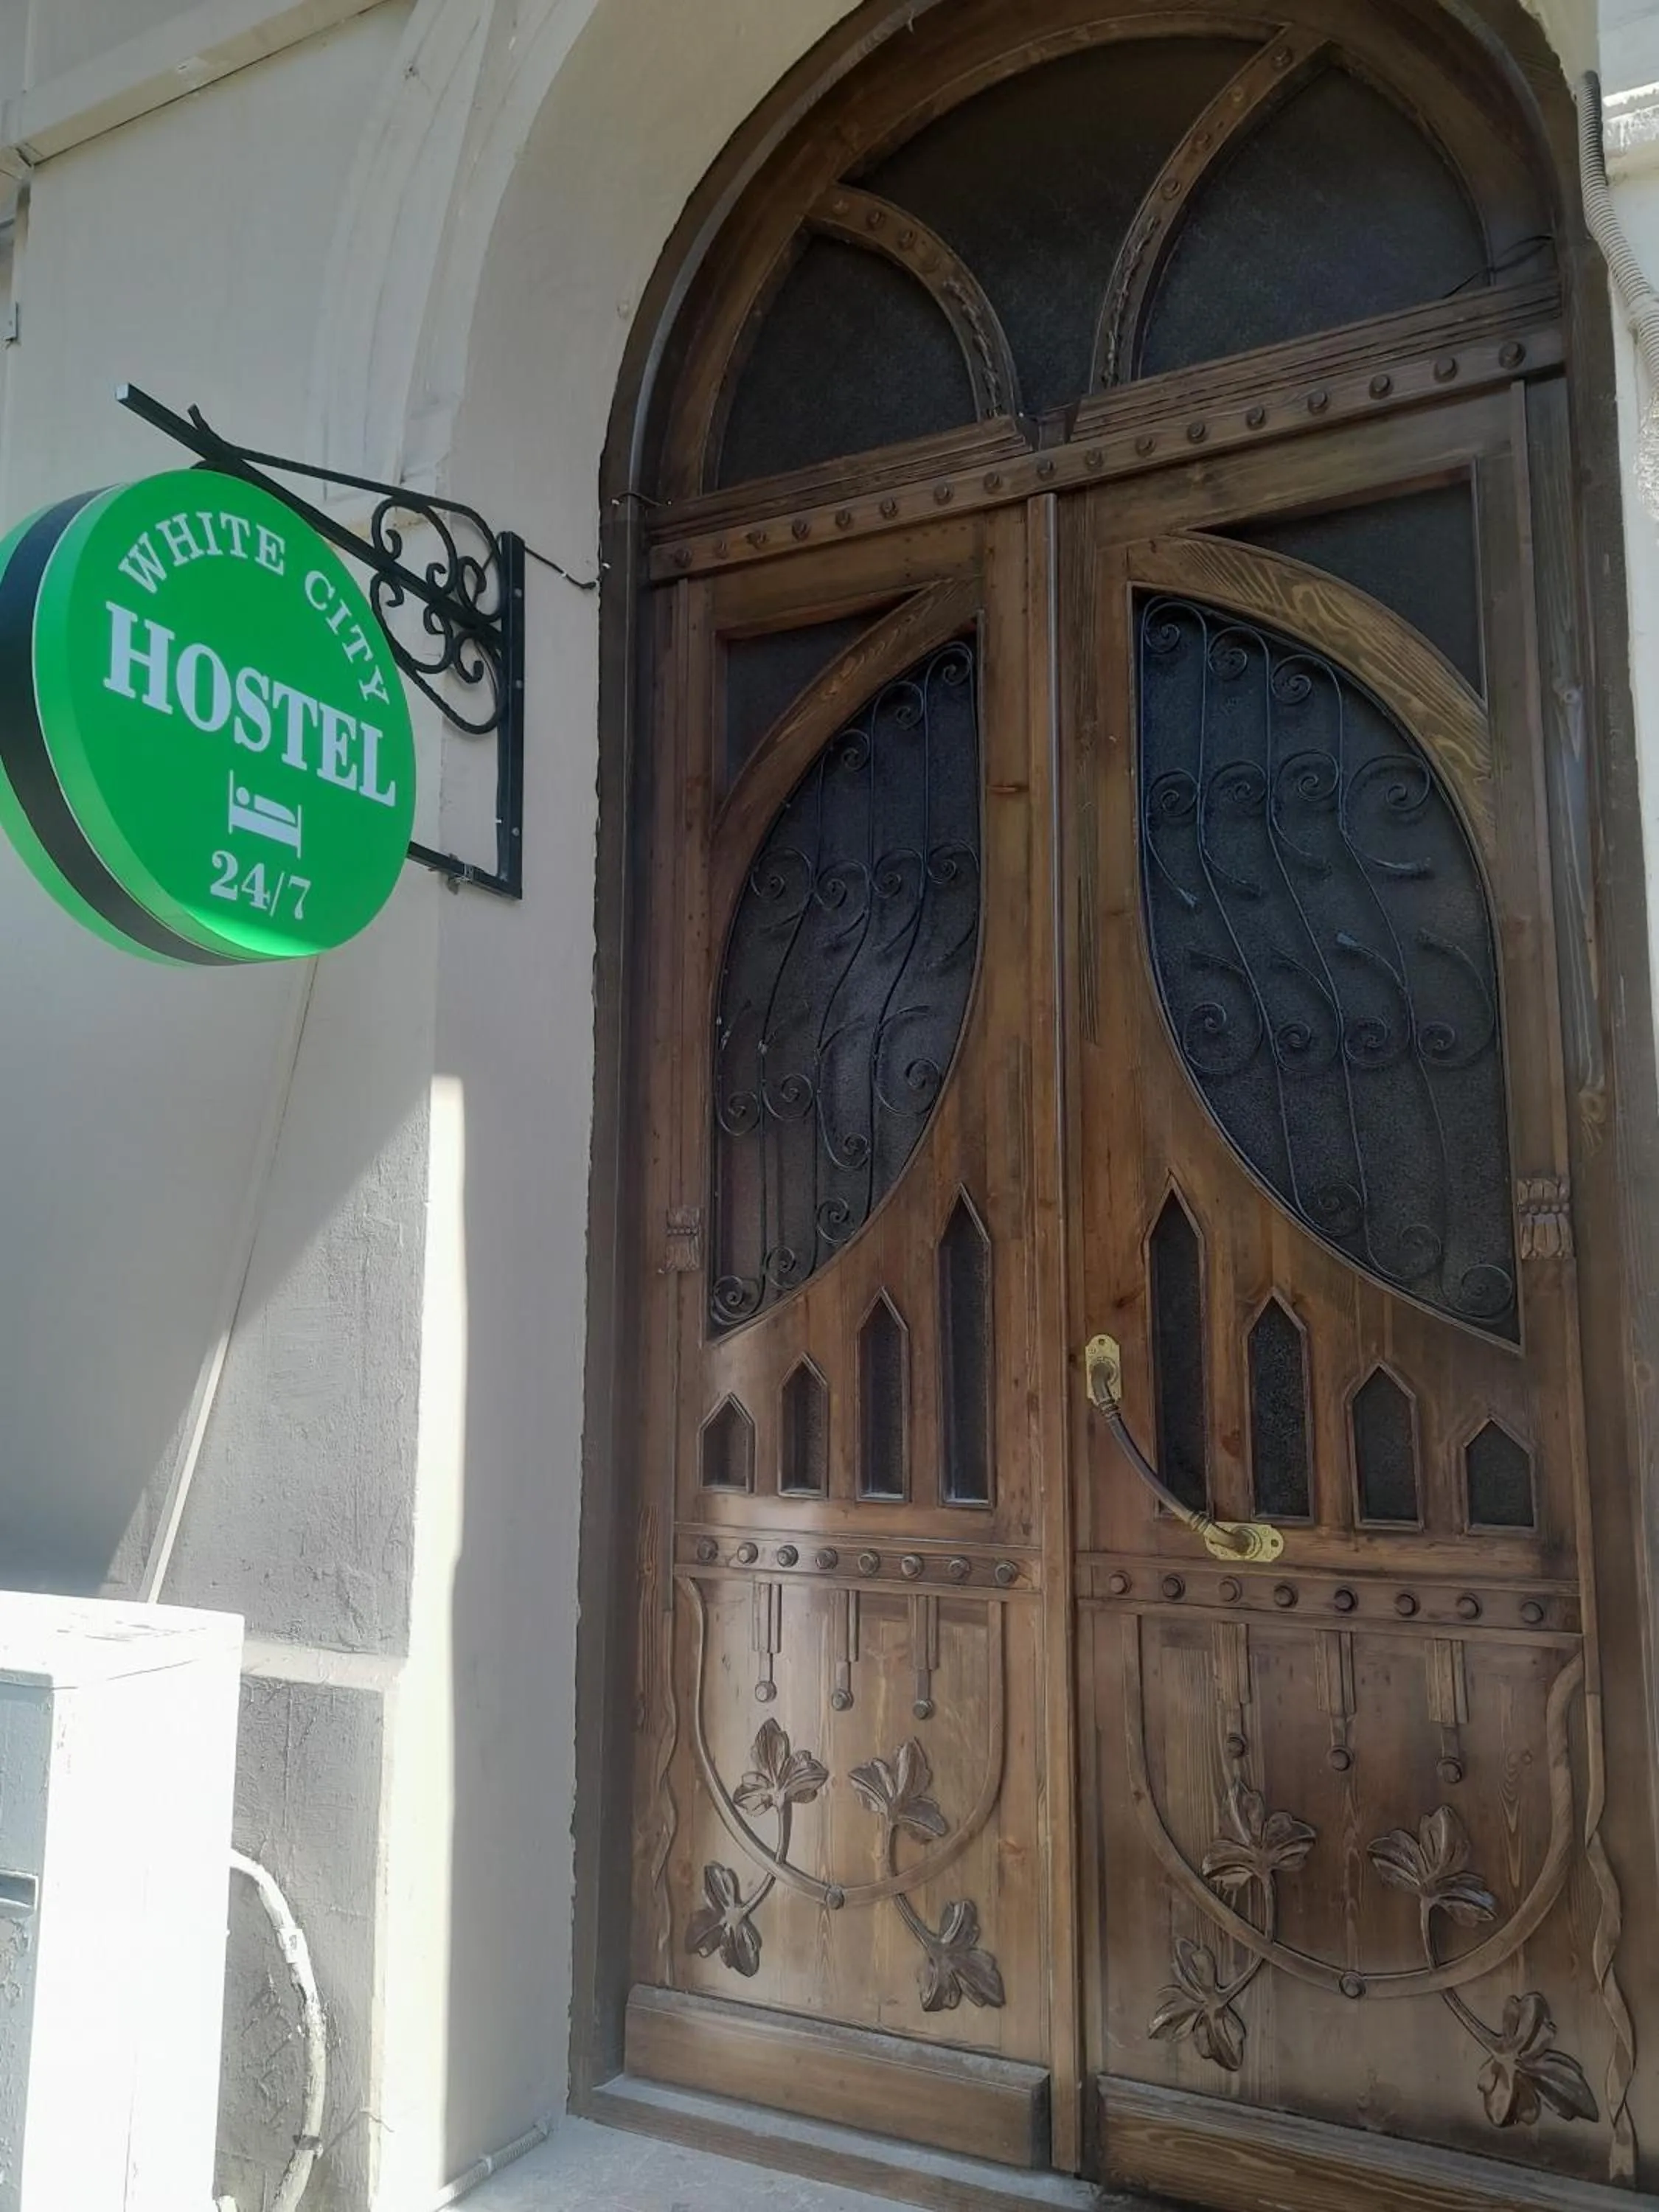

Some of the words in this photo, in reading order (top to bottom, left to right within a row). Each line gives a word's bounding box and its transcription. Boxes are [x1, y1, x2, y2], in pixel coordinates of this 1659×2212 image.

[103, 600, 397, 807] HOSTEL
[118, 512, 285, 595] WHITE
[304, 569, 391, 708] CITY
[209, 849, 311, 920] 24/7
